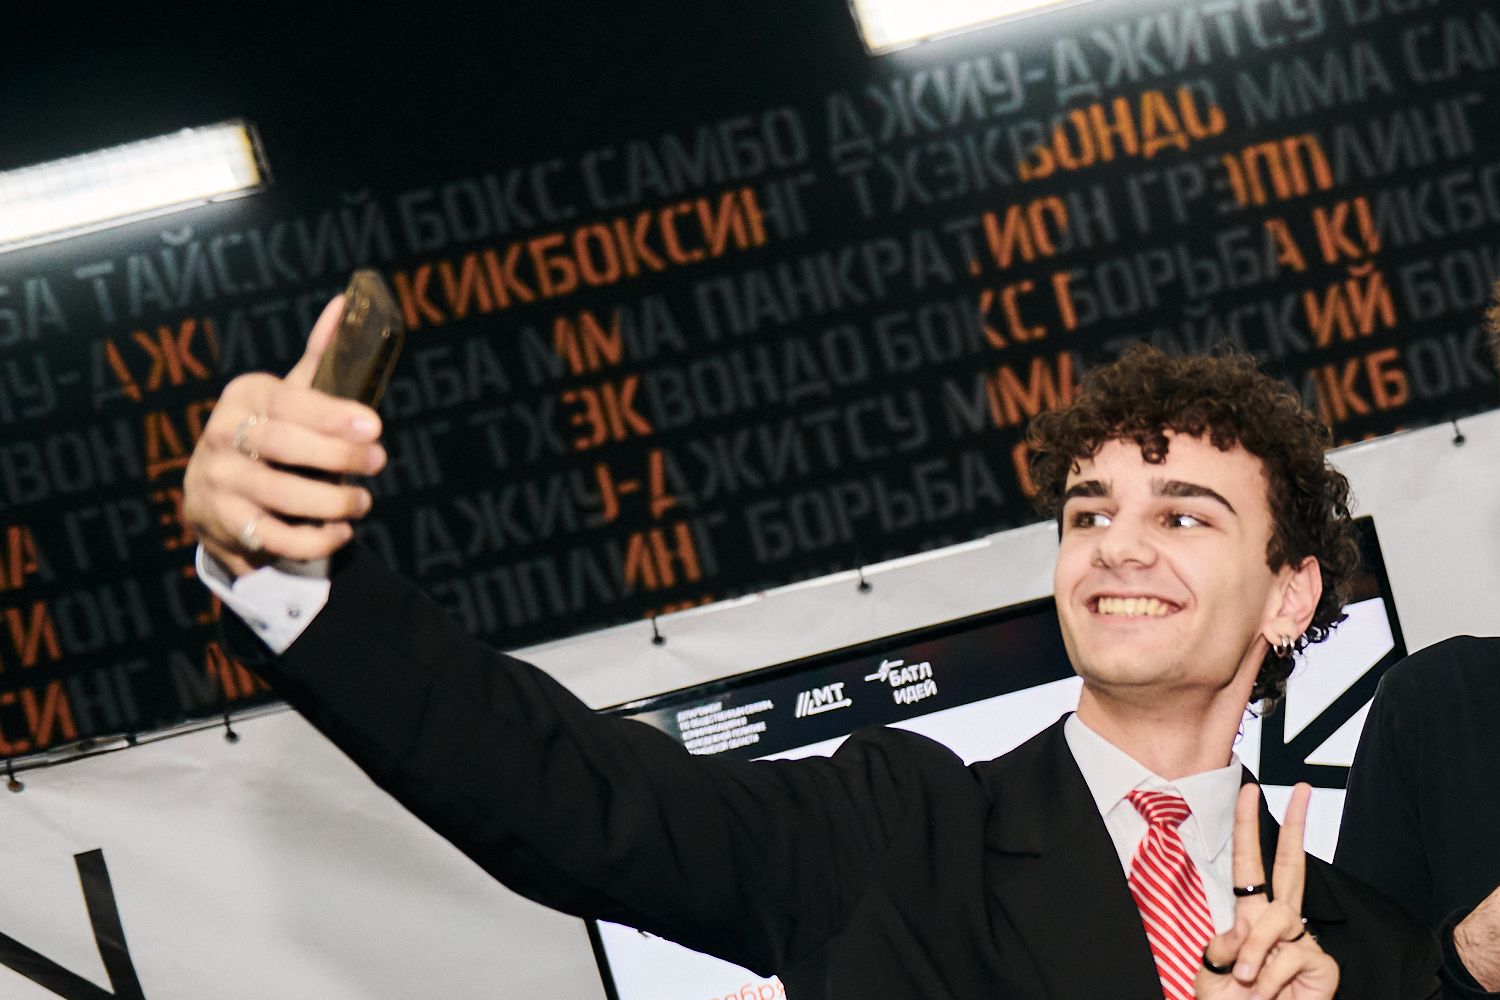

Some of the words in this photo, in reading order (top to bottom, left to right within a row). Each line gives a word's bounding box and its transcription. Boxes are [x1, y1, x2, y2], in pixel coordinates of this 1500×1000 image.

[74, 187, 394, 323] ТАЙСКИЙ
[399, 159, 577, 252] БОКС
[582, 107, 809, 209] САМБО
[393, 173, 816, 330] КИКБОКСИНГ
[836, 79, 1227, 218] ТХЭКВОНДО
[1236, 41, 1395, 128] ММА
[519, 295, 687, 386] ММА
[696, 187, 1118, 341] ПАНКРАТИОН
[1127, 93, 1483, 235] ГРЭППЛИНГ
[467, 322, 873, 470] ТХЭКВОНДО
[875, 279, 1047, 372] БОКС
[1052, 216, 1306, 332] БОРЬБА
[415, 392, 928, 576] ДЖИУ-ДЖИТСУ
[745, 449, 998, 562] БОРЬБА
[889, 662, 932, 688] БАТЛ
[893, 680, 938, 705] ИДЕЙ
